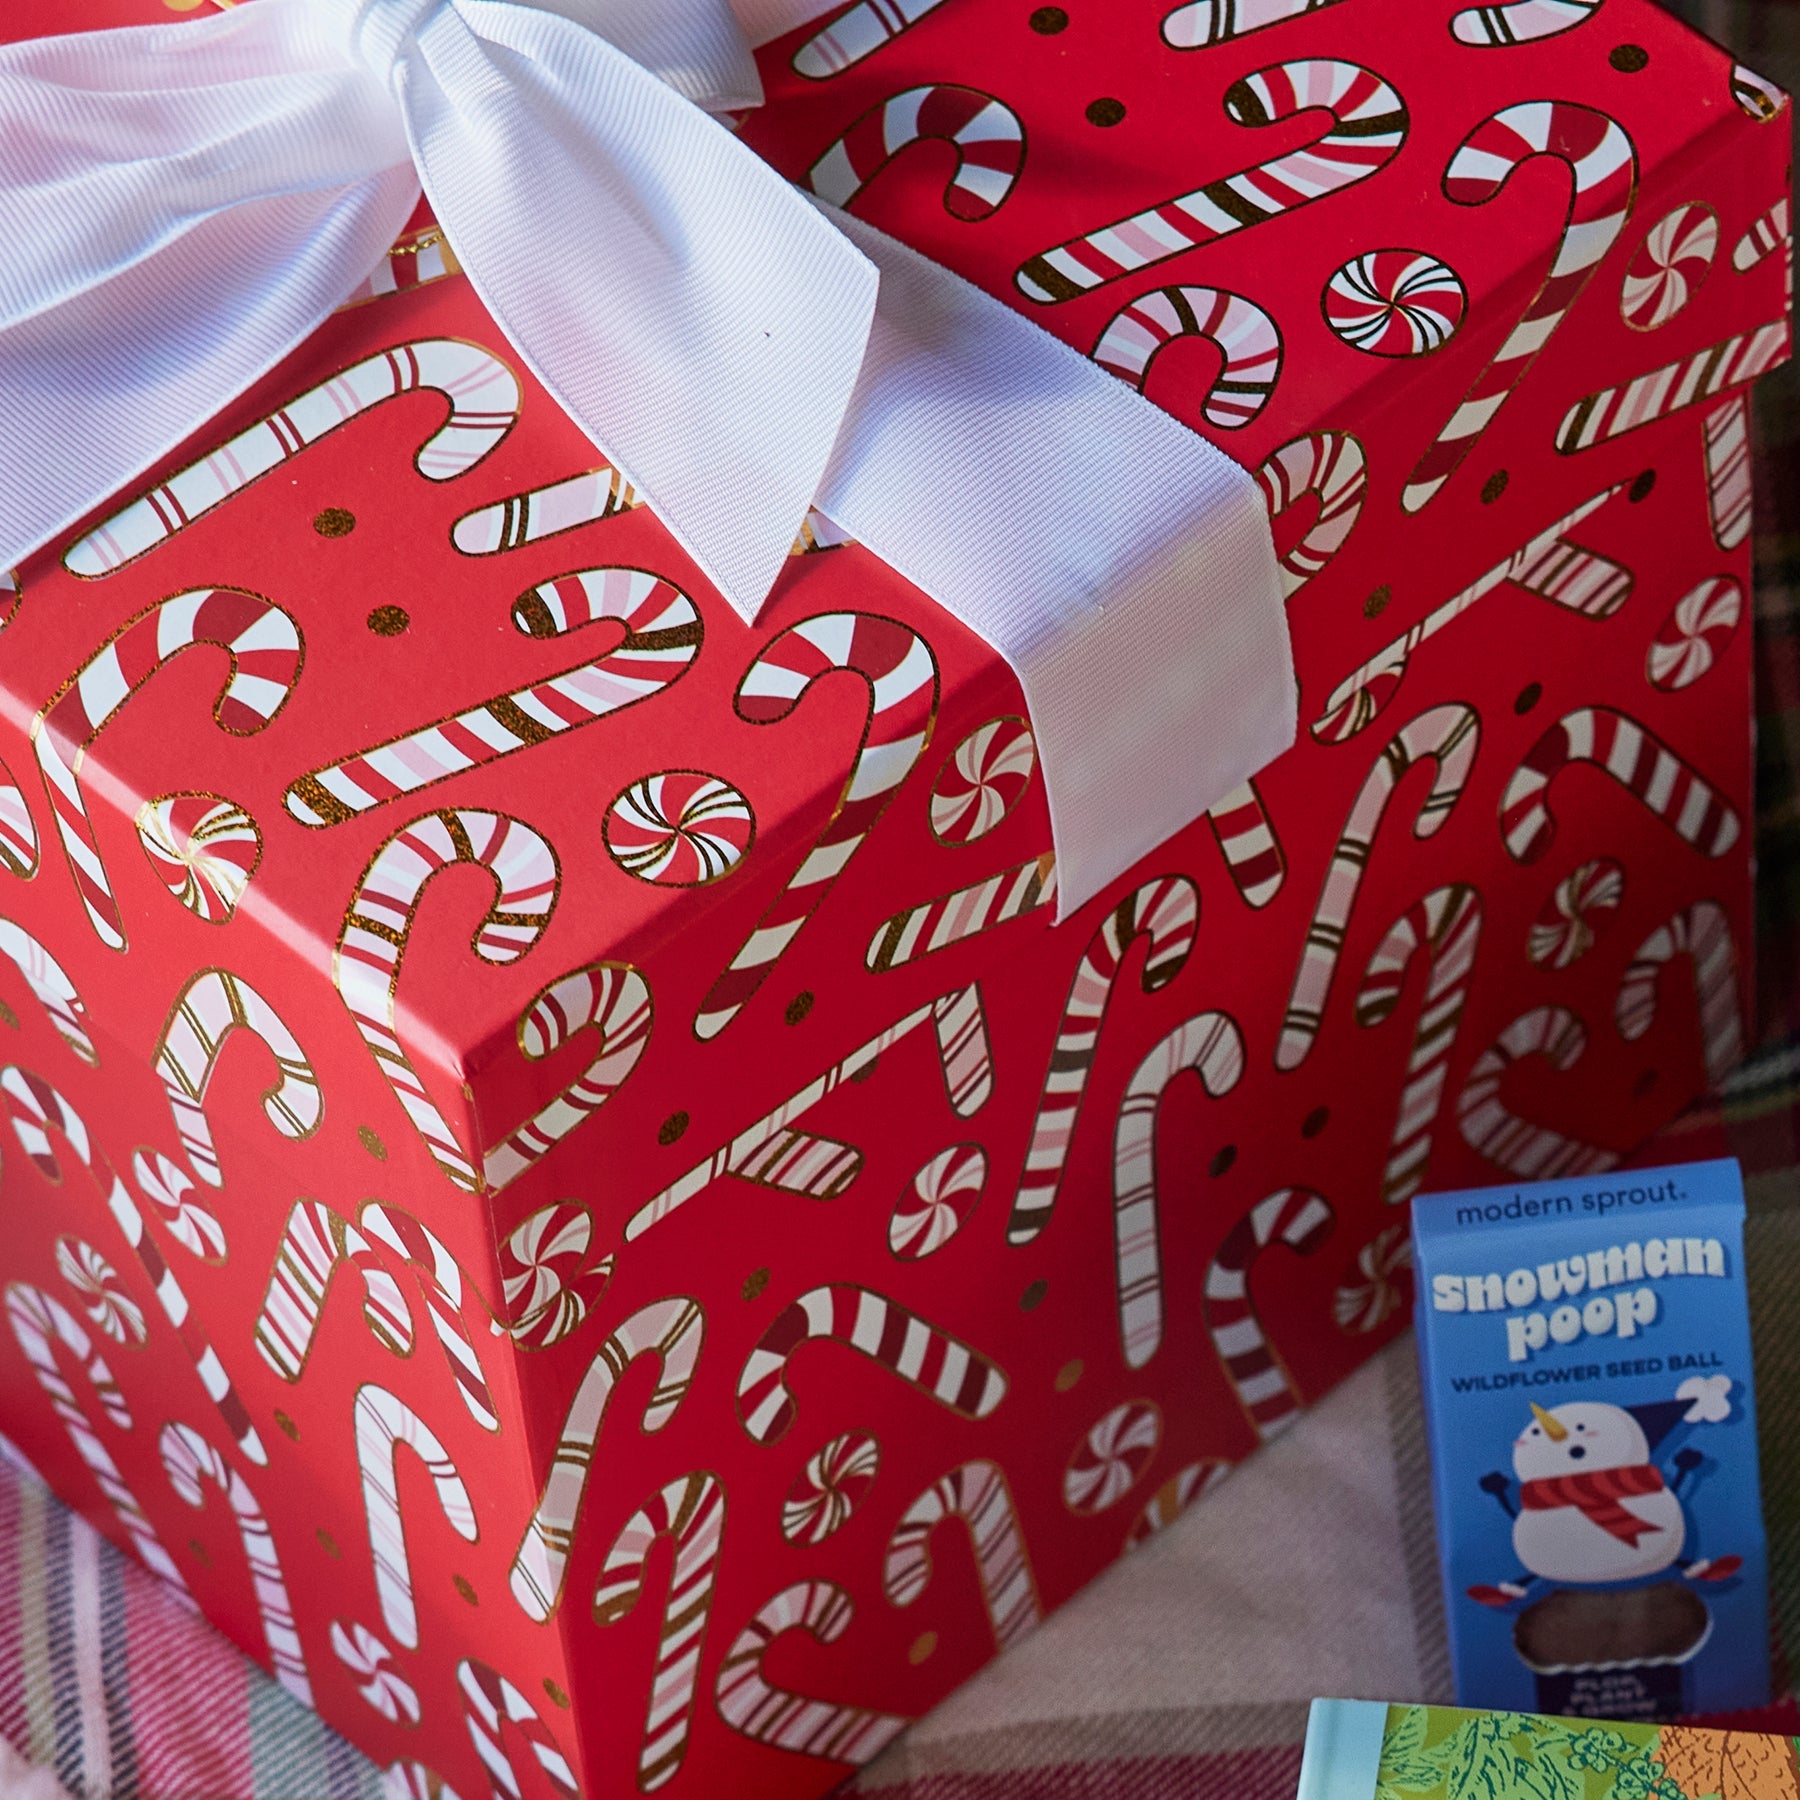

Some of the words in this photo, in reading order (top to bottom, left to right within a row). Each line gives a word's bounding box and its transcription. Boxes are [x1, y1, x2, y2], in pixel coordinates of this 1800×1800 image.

[1456, 1191, 1573, 1225] modern
[1433, 1237, 1725, 1312] snowman
[1507, 1288, 1657, 1361] poop
[1451, 1364, 1601, 1393] WILDFLOWER
[1607, 1358, 1662, 1377] SEED
[1667, 1352, 1724, 1370] BALL
